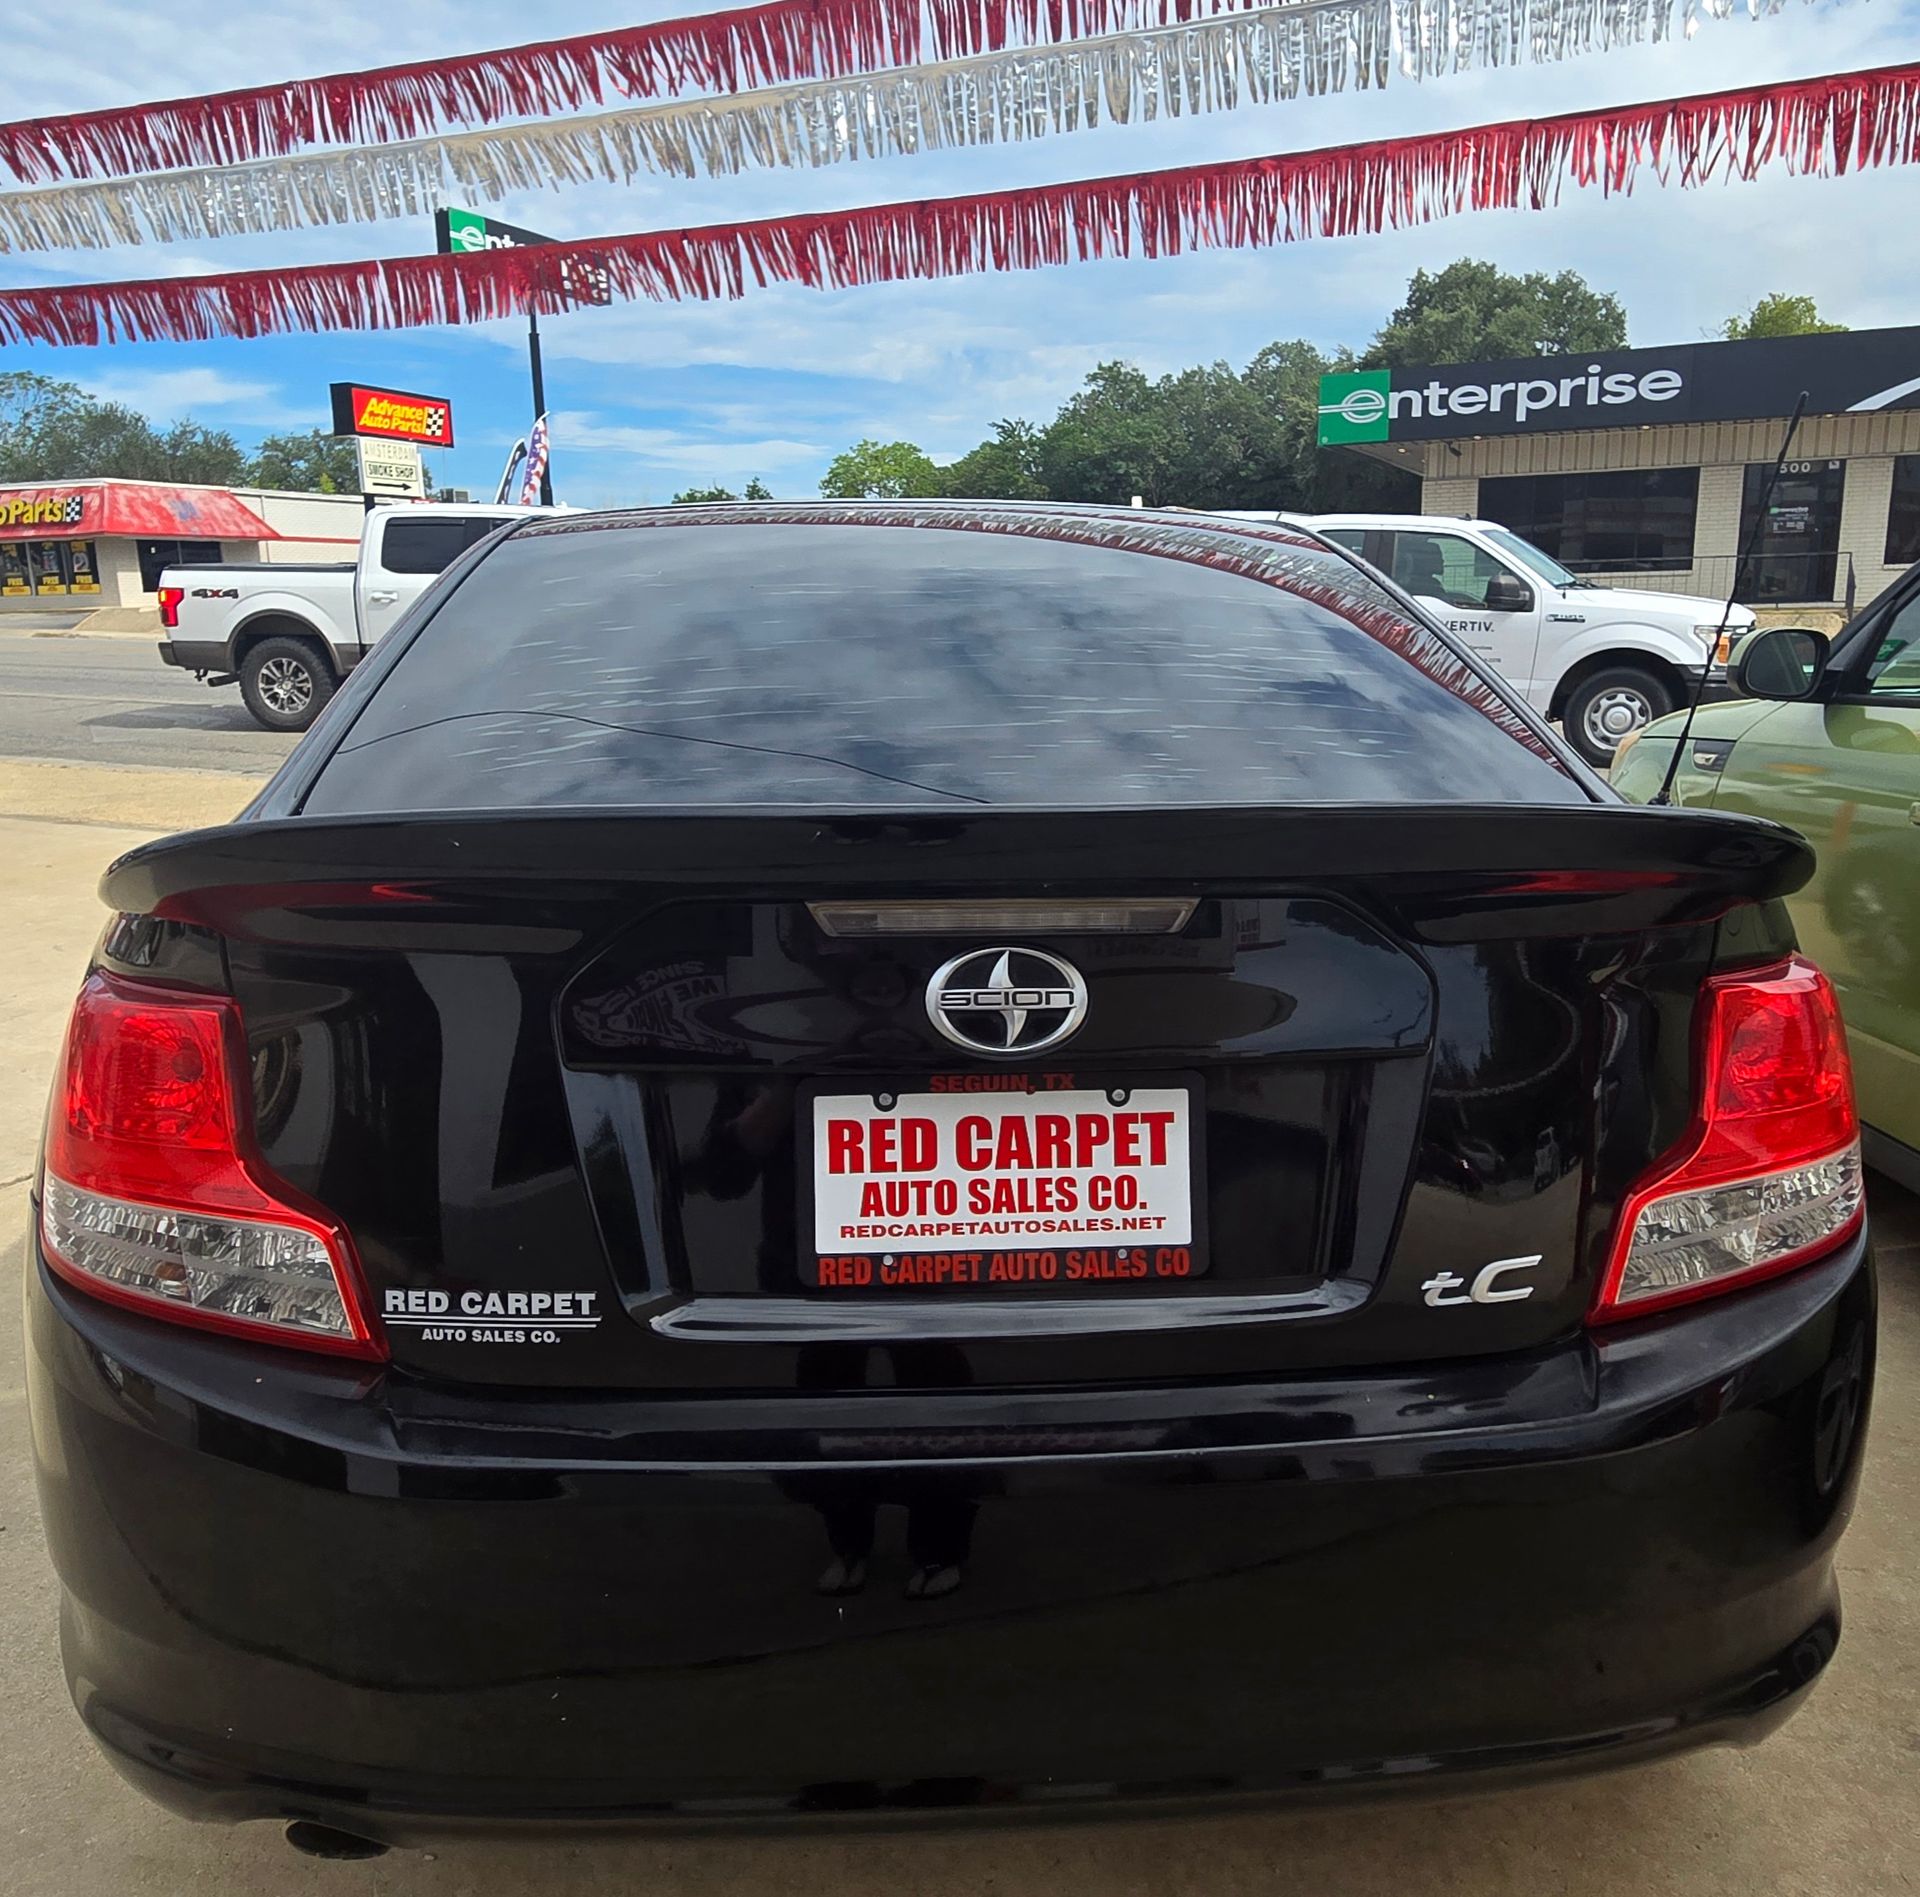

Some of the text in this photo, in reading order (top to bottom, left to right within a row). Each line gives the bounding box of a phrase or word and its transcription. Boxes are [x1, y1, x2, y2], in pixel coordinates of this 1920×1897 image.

[1318, 364, 1683, 422] enterprise
[366, 397, 423, 420] Advance
[359, 413, 423, 433] Auto Parts
[368, 464, 414, 478] SMOKE SHOP
[1780, 462, 1811, 474] 500
[9, 498, 62, 524] Parts
[941, 991, 1075, 1006] SCION
[1043, 1073, 1075, 1090] TX
[827, 1111, 1175, 1174] RED CARPET
[859, 1175, 1148, 1217] AUTO SALES CO.
[840, 1216, 1167, 1239] REDCARPETAUTOSALES.NET
[818, 1248, 1190, 1286] RED CARPET AUTO SALES CO
[384, 1289, 597, 1315] RED CARPET
[422, 1328, 561, 1344] AUTO SALES CO.
